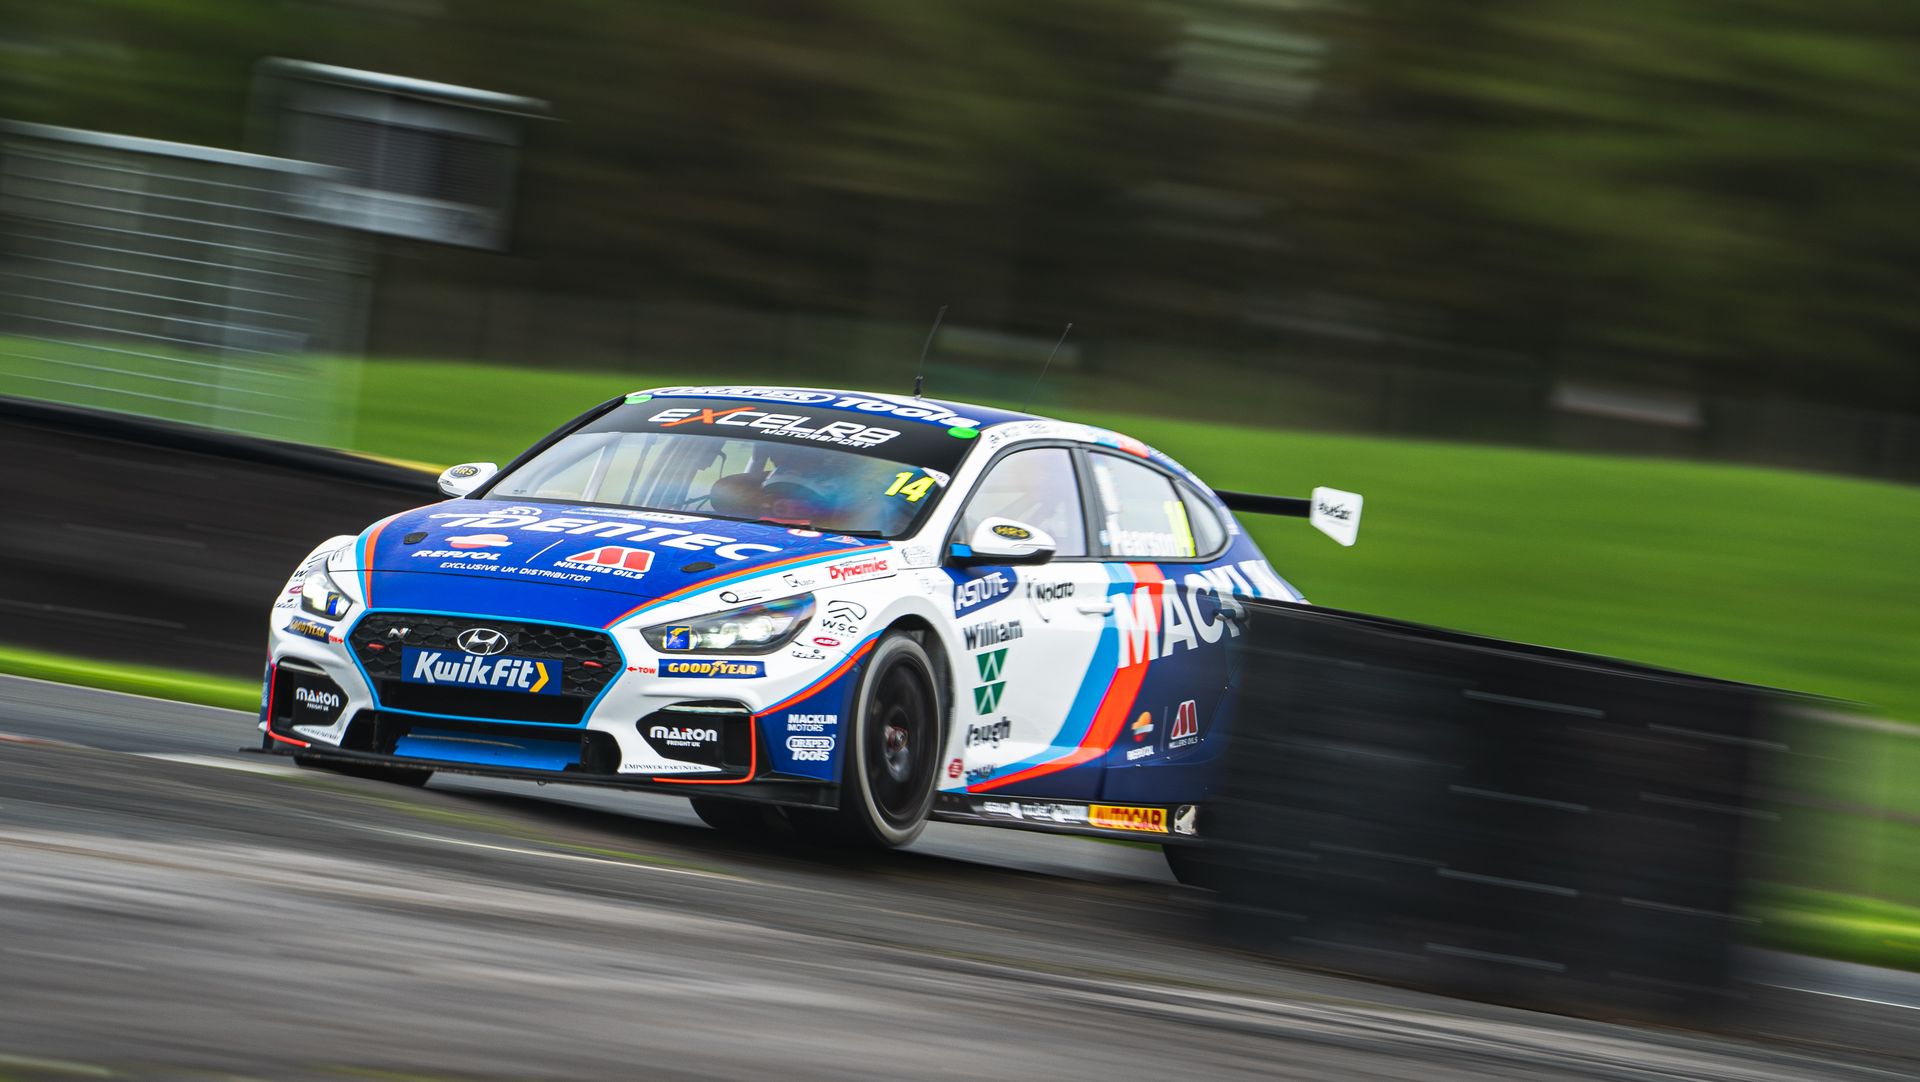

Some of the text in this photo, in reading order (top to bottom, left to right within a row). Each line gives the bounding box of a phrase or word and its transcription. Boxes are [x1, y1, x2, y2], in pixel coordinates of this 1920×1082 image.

[648, 406, 901, 444] EXCELR8
[760, 428, 877, 448] MOTORSPORT
[884, 471, 935, 503] 14
[412, 550, 502, 560] REPSOL
[440, 562, 500, 572] EXCLUSIVE
[519, 567, 592, 583] DISTRIBUTOR
[553, 560, 645, 580] MILLERS OILS
[829, 557, 888, 581] Dynamics
[956, 571, 1009, 611] ASTUTE
[822, 619, 858, 634] WSC
[963, 619, 1023, 651] William
[638, 666, 656, 674] TOW
[668, 661, 757, 677] GOODYEAR
[788, 714, 837, 724] MACKLIN
[667, 739, 690, 747] FREIGHT
[791, 739, 830, 748] DRAPER
[1094, 806, 1163, 831] AUTOCAR
